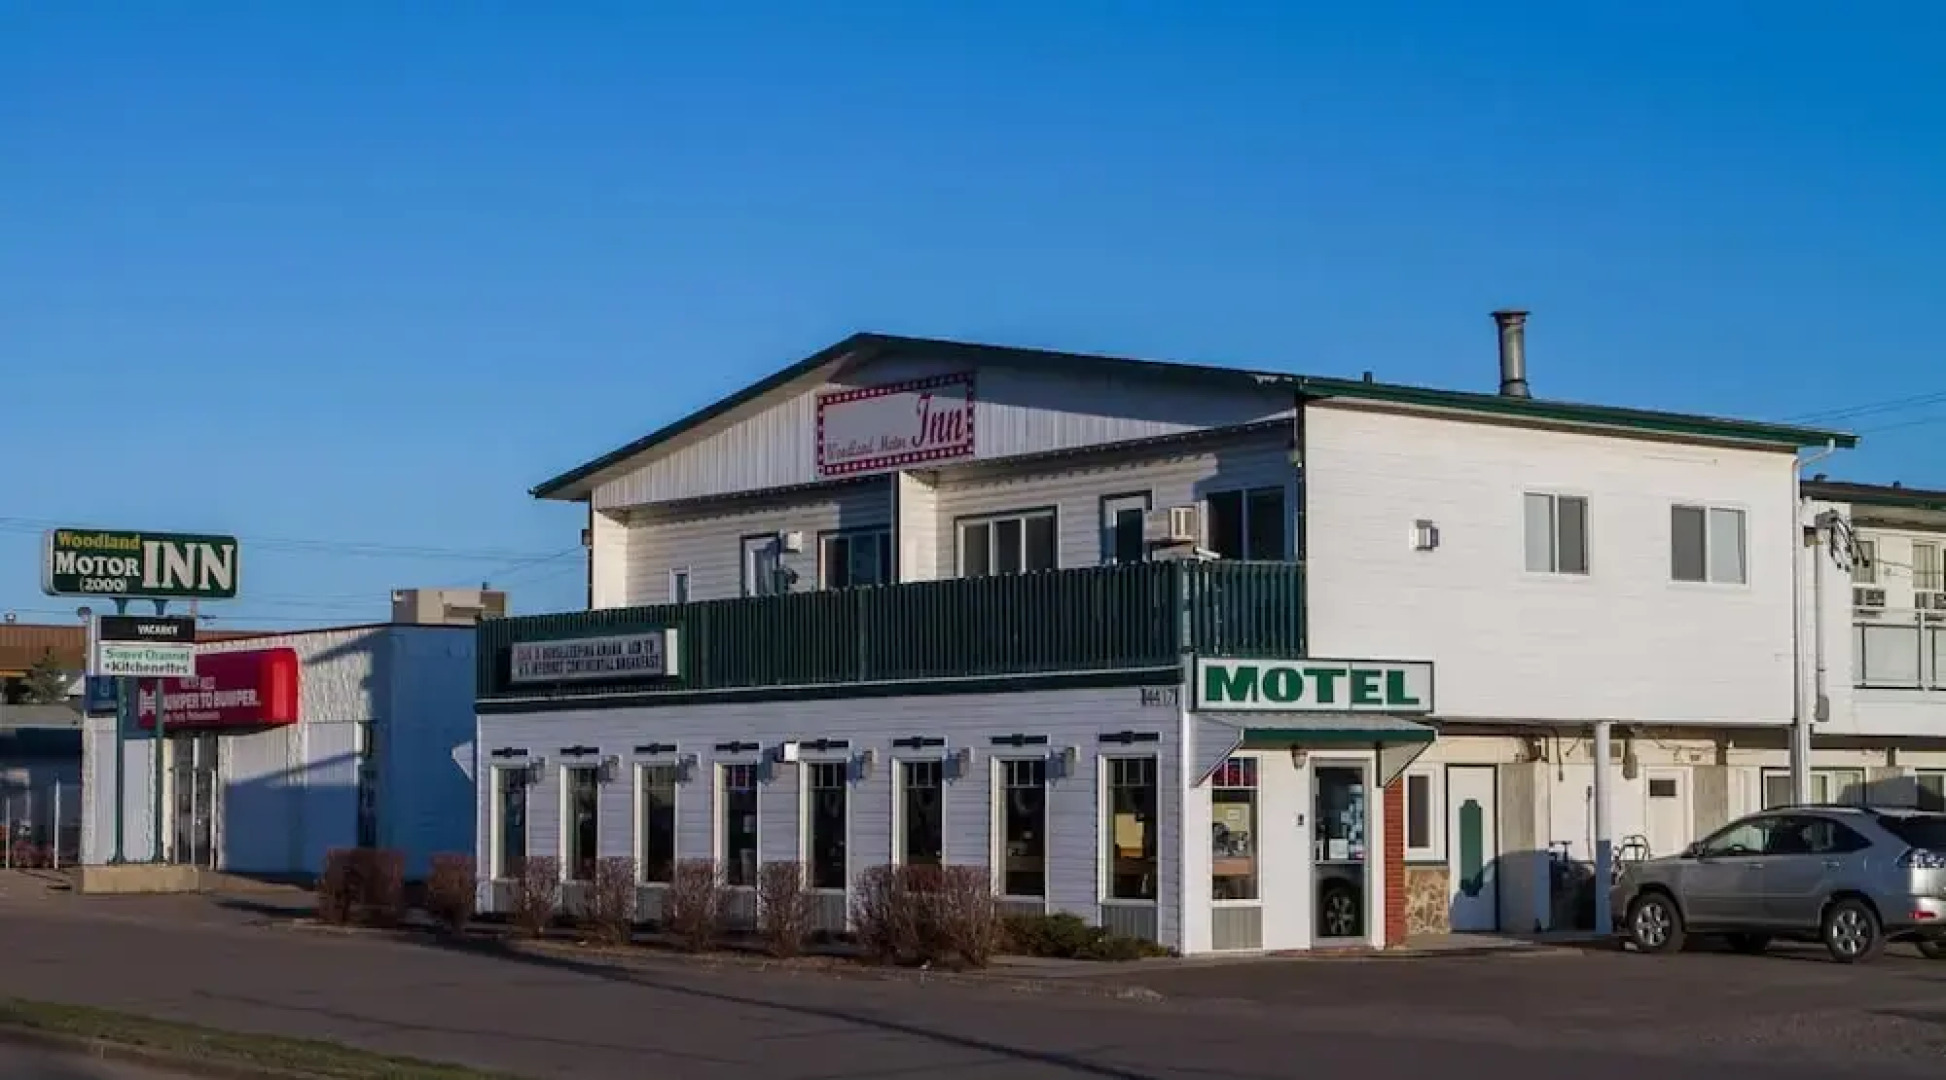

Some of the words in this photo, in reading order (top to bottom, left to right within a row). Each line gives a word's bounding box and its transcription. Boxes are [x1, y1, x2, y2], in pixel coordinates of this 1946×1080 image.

[912, 394, 963, 447] Inn
[58, 532, 140, 548] Woodland
[55, 552, 140, 577] MOTOR
[143, 542, 234, 590] INN
[79, 577, 128, 593] (2000)
[138, 625, 178, 635] VACANCY
[106, 649, 143, 661] Super
[145, 649, 190, 662] Channel
[1205, 665, 1419, 705] MOTEL
